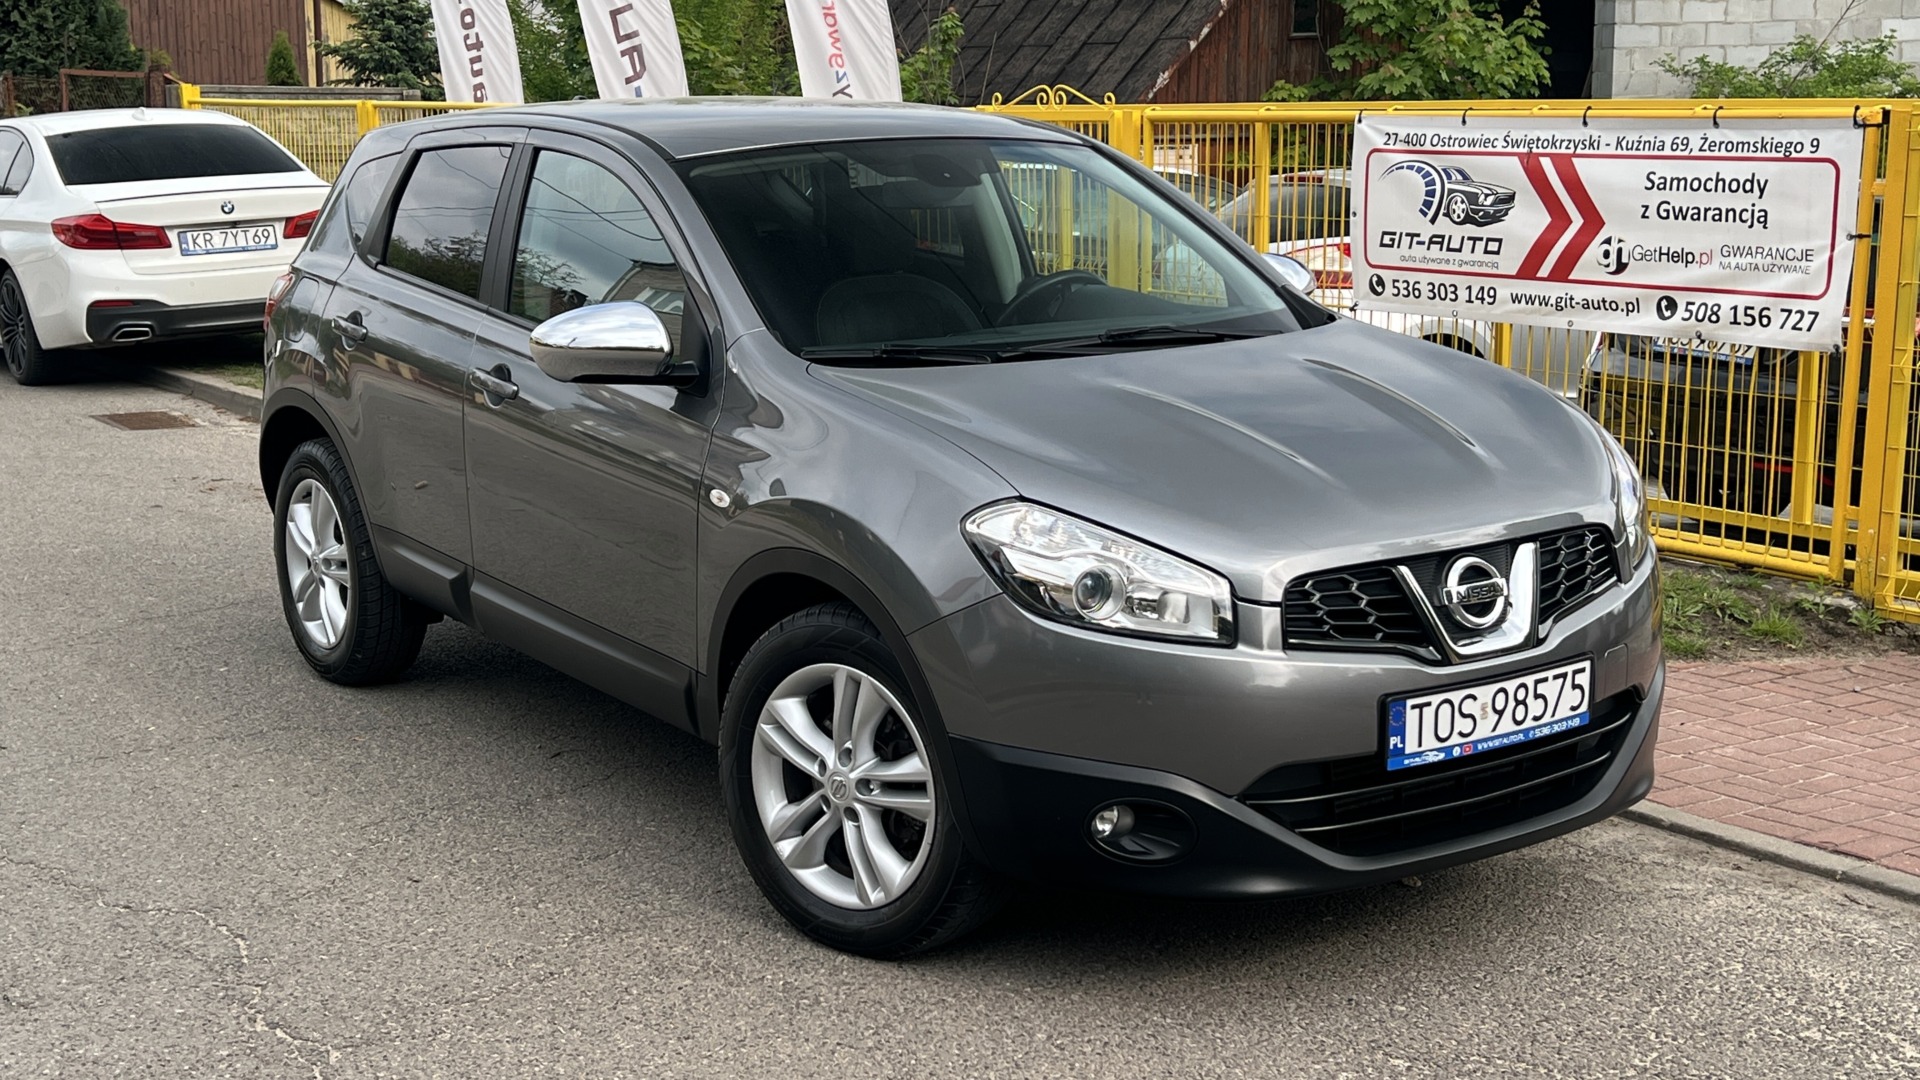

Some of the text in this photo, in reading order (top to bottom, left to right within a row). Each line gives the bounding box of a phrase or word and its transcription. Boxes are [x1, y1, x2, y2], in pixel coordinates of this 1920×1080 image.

[1383, 132, 1427, 147] 27-400
[1430, 133, 1498, 149] Ostrowiec
[1501, 131, 1601, 154] Świętokrzyski
[1615, 135, 1665, 152] Kuźnia
[1670, 136, 1693, 155] 69,
[1698, 133, 1805, 158] Żeromskiego
[1810, 137, 1820, 154] 9
[1644, 171, 1769, 199] Samochody
[1640, 200, 1769, 229] z Gwarancją
[191, 228, 271, 249] KR 7YT69
[1379, 231, 1504, 256] GIT-AUTO
[1399, 254, 1417, 263] auta
[1418, 255, 1451, 267] używane
[1457, 258, 1499, 270] gwarancją
[1631, 244, 1713, 268] GetHelp.pl
[1720, 244, 1815, 263] GWARANCJE
[1719, 260, 1811, 275] NA AUTA UŻYWANE
[1391, 279, 1498, 306] 536 303 149
[1510, 290, 1641, 317] www.git-auto.pl
[1681, 300, 1820, 333] 508 156 727
[1455, 582, 1505, 602] NISSAN
[1410, 666, 1587, 749] TOS 98575
[1389, 735, 1404, 750] PL
